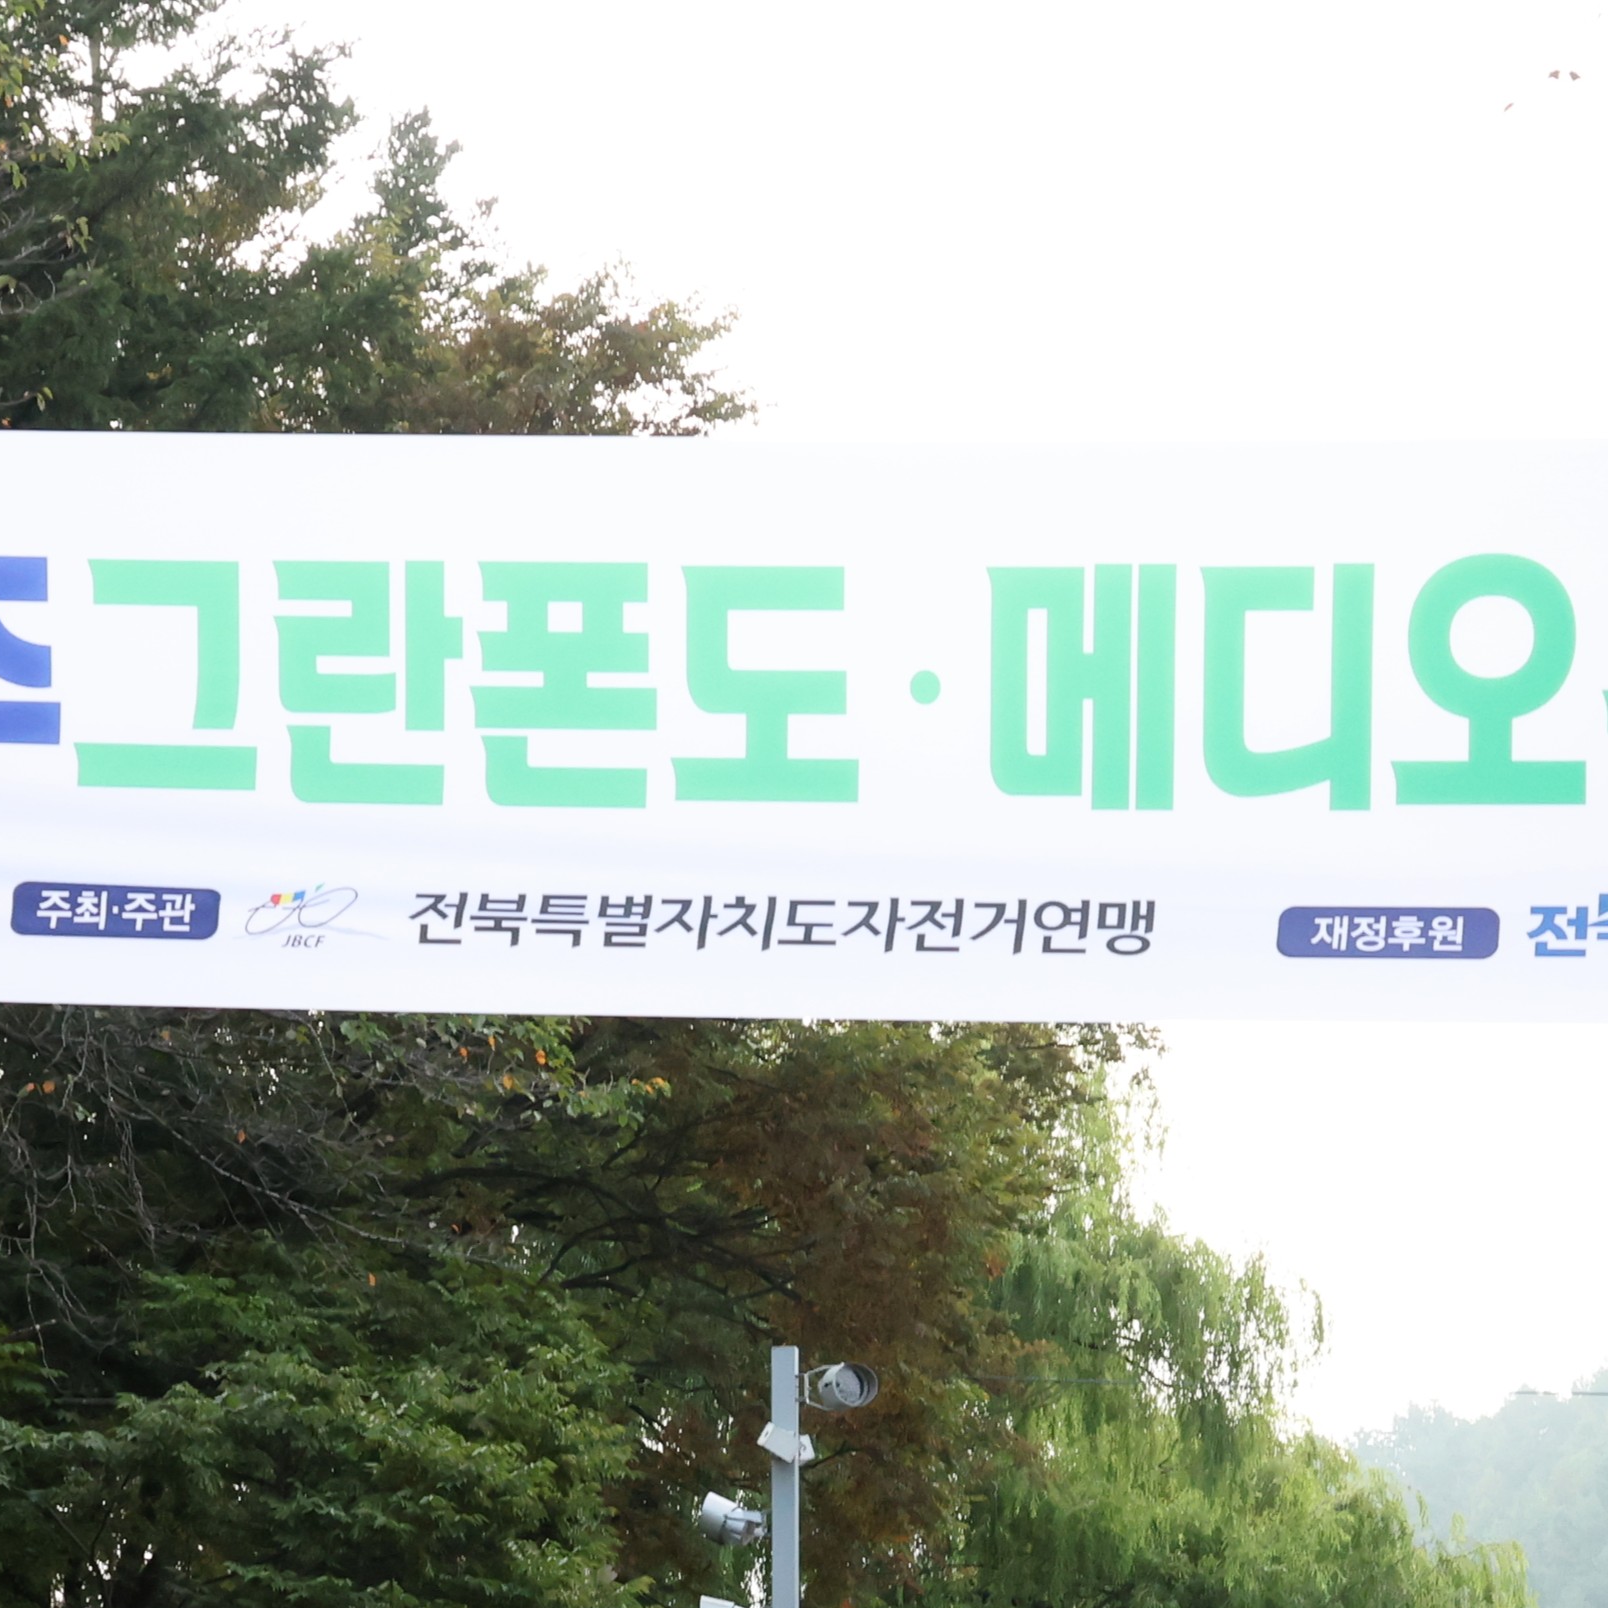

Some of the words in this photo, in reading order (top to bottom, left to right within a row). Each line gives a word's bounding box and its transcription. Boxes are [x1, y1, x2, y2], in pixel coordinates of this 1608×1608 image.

[35, 889, 196, 932] 주최·주관
[408, 891, 1156, 956] 전북특별자치도자전거연맹
[281, 934, 326, 948] JBCF
[1309, 914, 1465, 952] 재정후원
